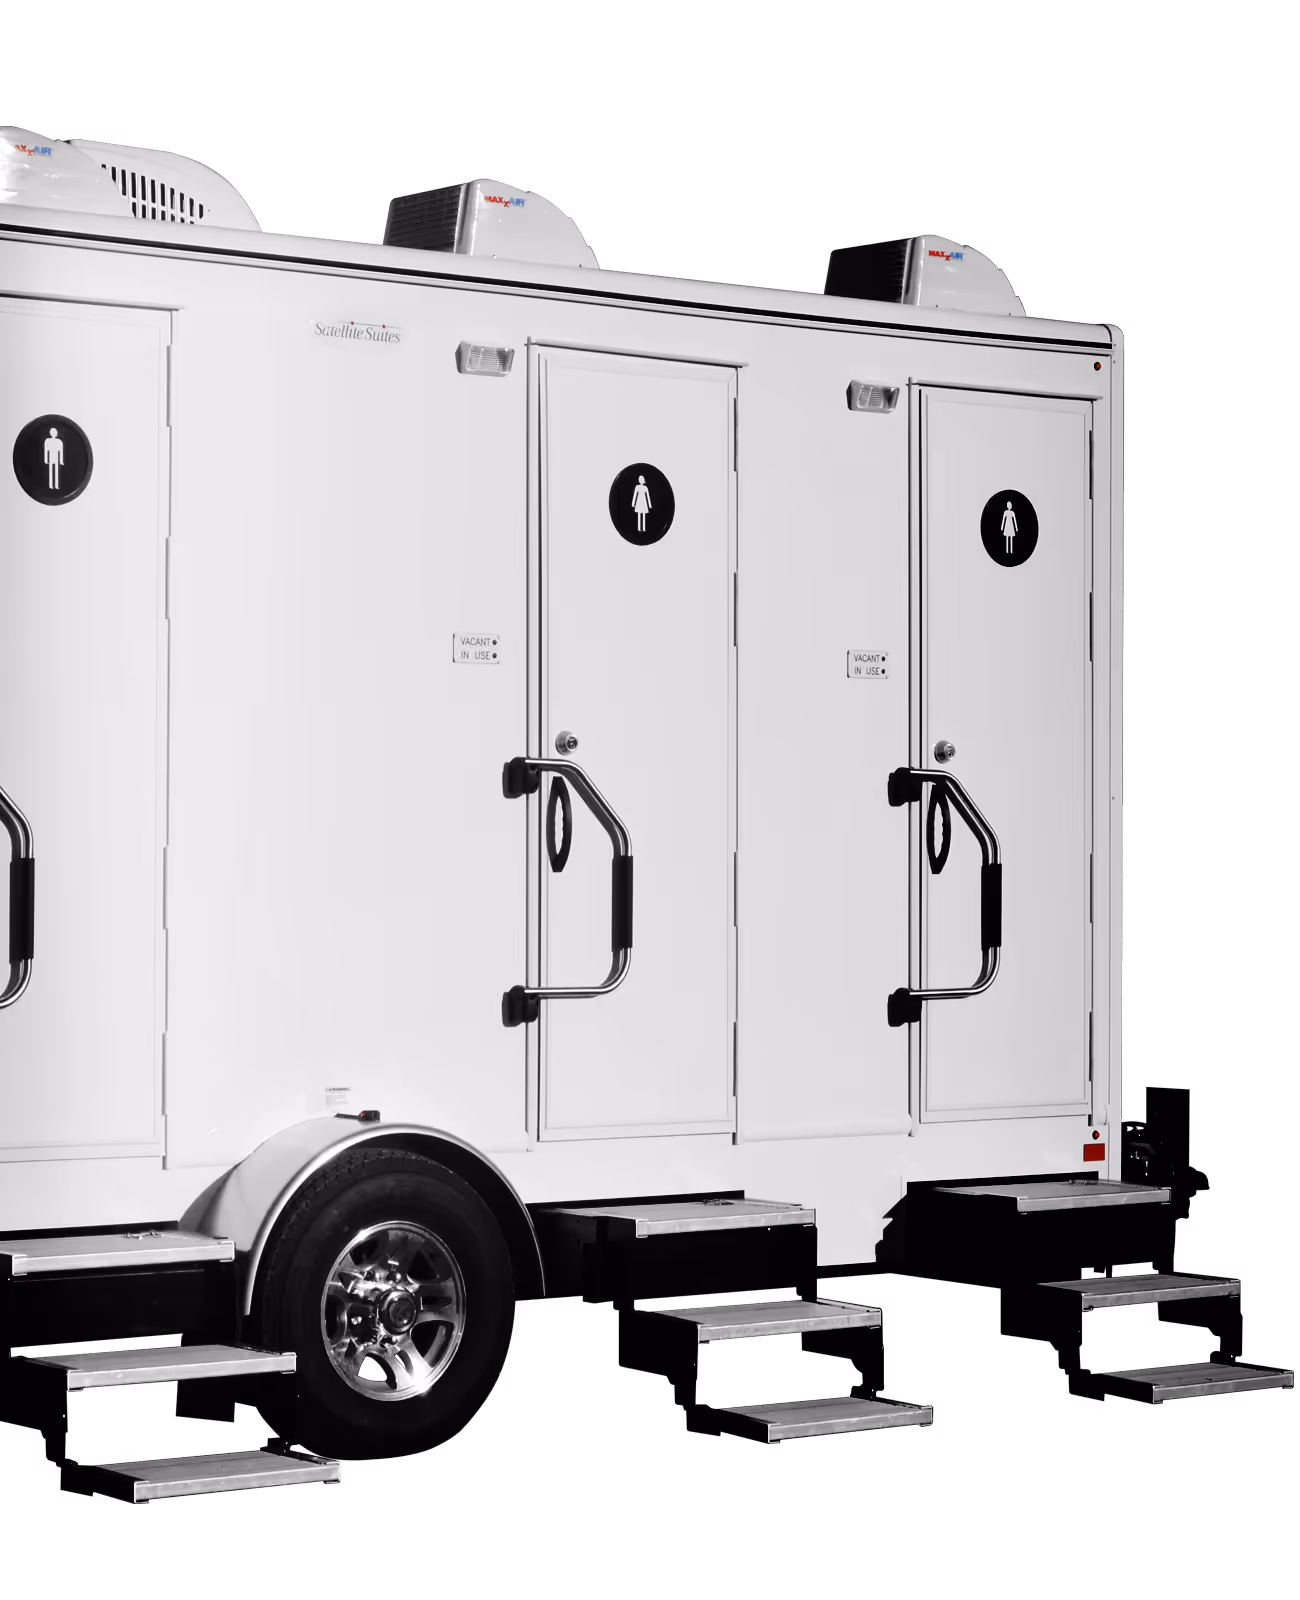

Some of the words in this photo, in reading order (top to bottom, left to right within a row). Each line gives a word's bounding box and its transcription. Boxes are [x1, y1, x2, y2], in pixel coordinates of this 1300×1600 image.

[314, 321, 363, 341] Satellite
[365, 325, 401, 344] Suites
[460, 637, 491, 646] VACANT
[460, 650, 469, 660] IN
[475, 651, 491, 661] USE
[854, 654, 880, 663] VACANT
[854, 666, 862, 675] IN
[866, 666, 880, 676] USE
